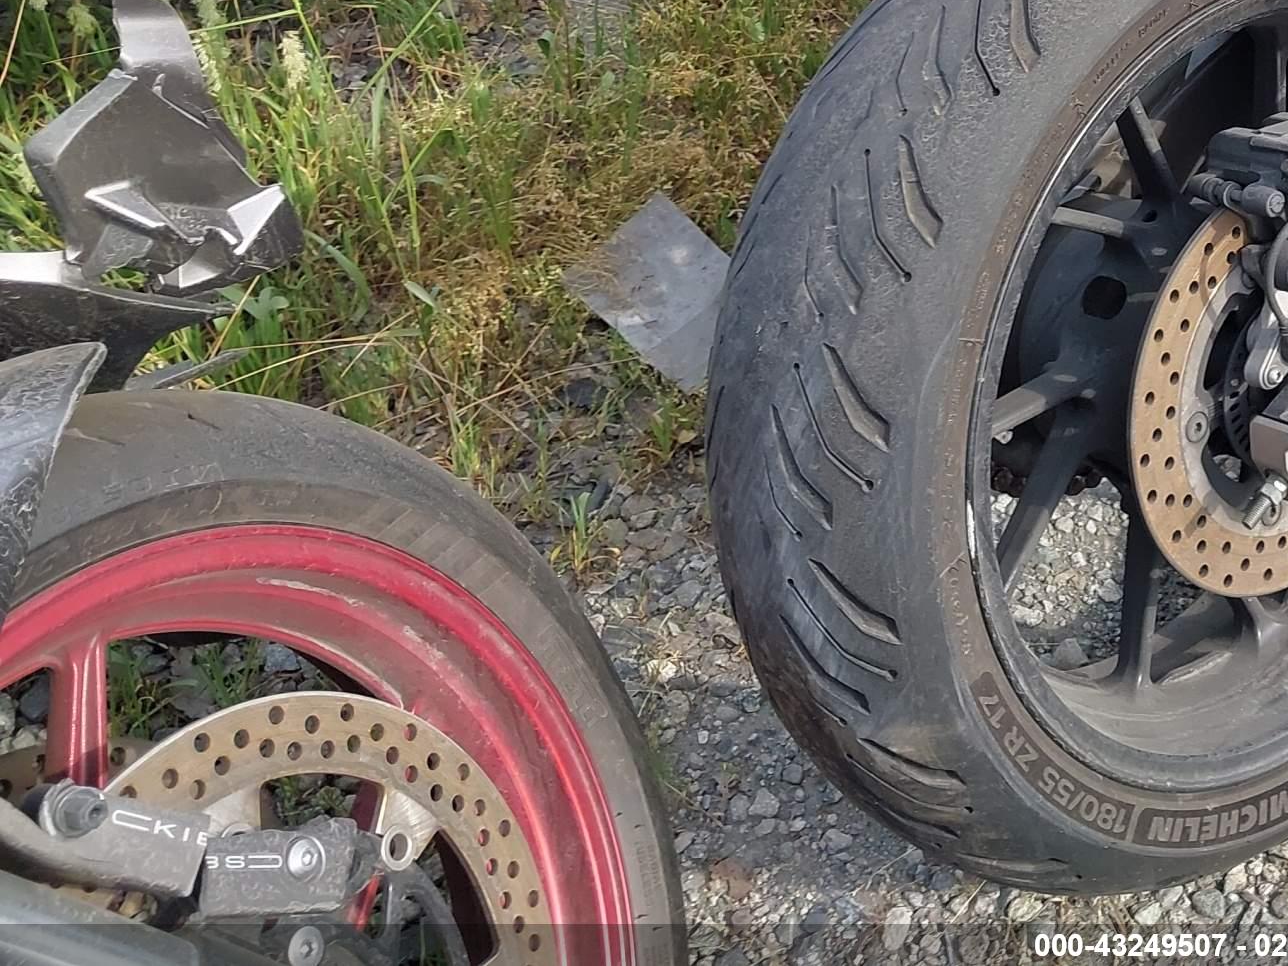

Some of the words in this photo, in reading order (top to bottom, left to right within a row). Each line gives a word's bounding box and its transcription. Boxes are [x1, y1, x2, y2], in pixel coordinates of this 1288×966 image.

[979, 693, 1002, 731] 17
[1003, 726, 1039, 772] ZR
[1038, 769, 1130, 834] 180/55
